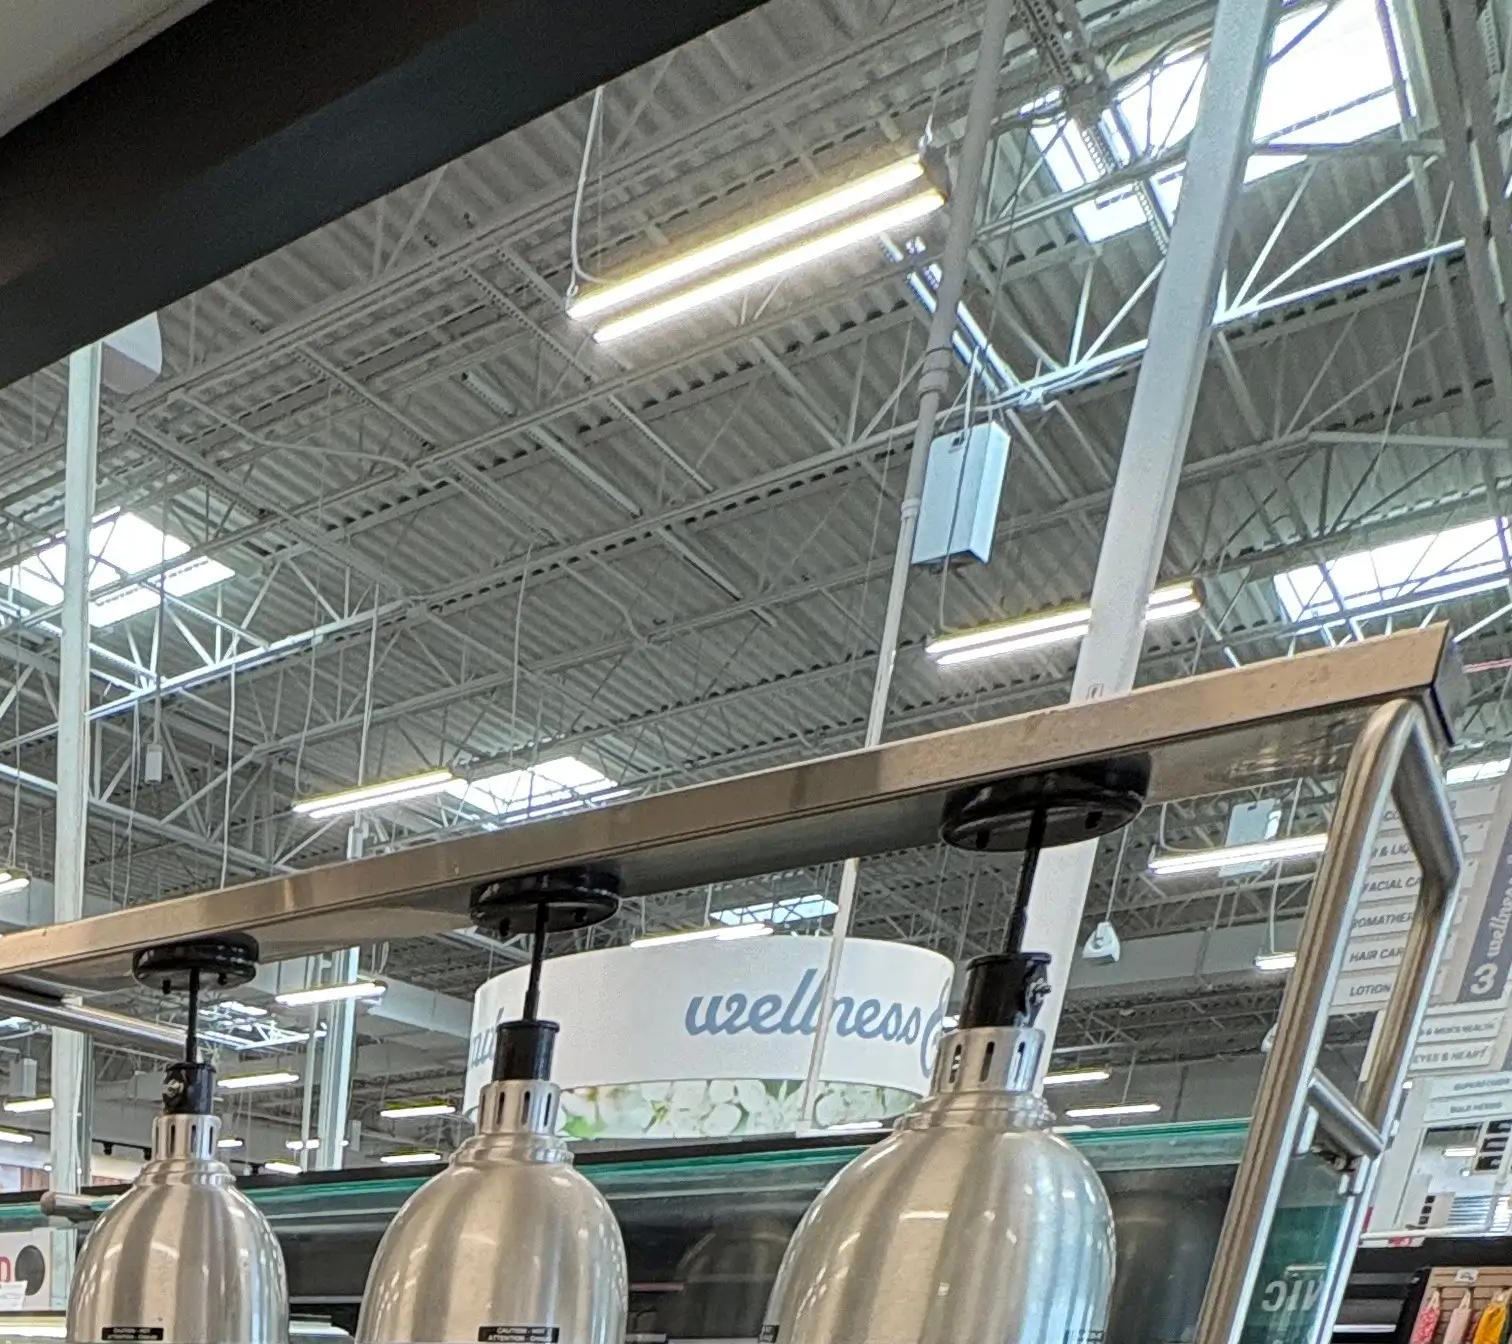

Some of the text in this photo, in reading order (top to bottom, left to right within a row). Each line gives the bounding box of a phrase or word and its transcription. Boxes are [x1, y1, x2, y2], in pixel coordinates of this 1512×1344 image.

[1349, 946, 1405, 962] HAIR CAR
[1470, 962, 1498, 994] 3
[1349, 983, 1392, 997] LOTION
[686, 967, 921, 1046] wellness
[1451, 1048, 1486, 1061] HEART
[496, 1326, 527, 1335] CAUTION
[488, 1334, 525, 1342] ATTENTION
